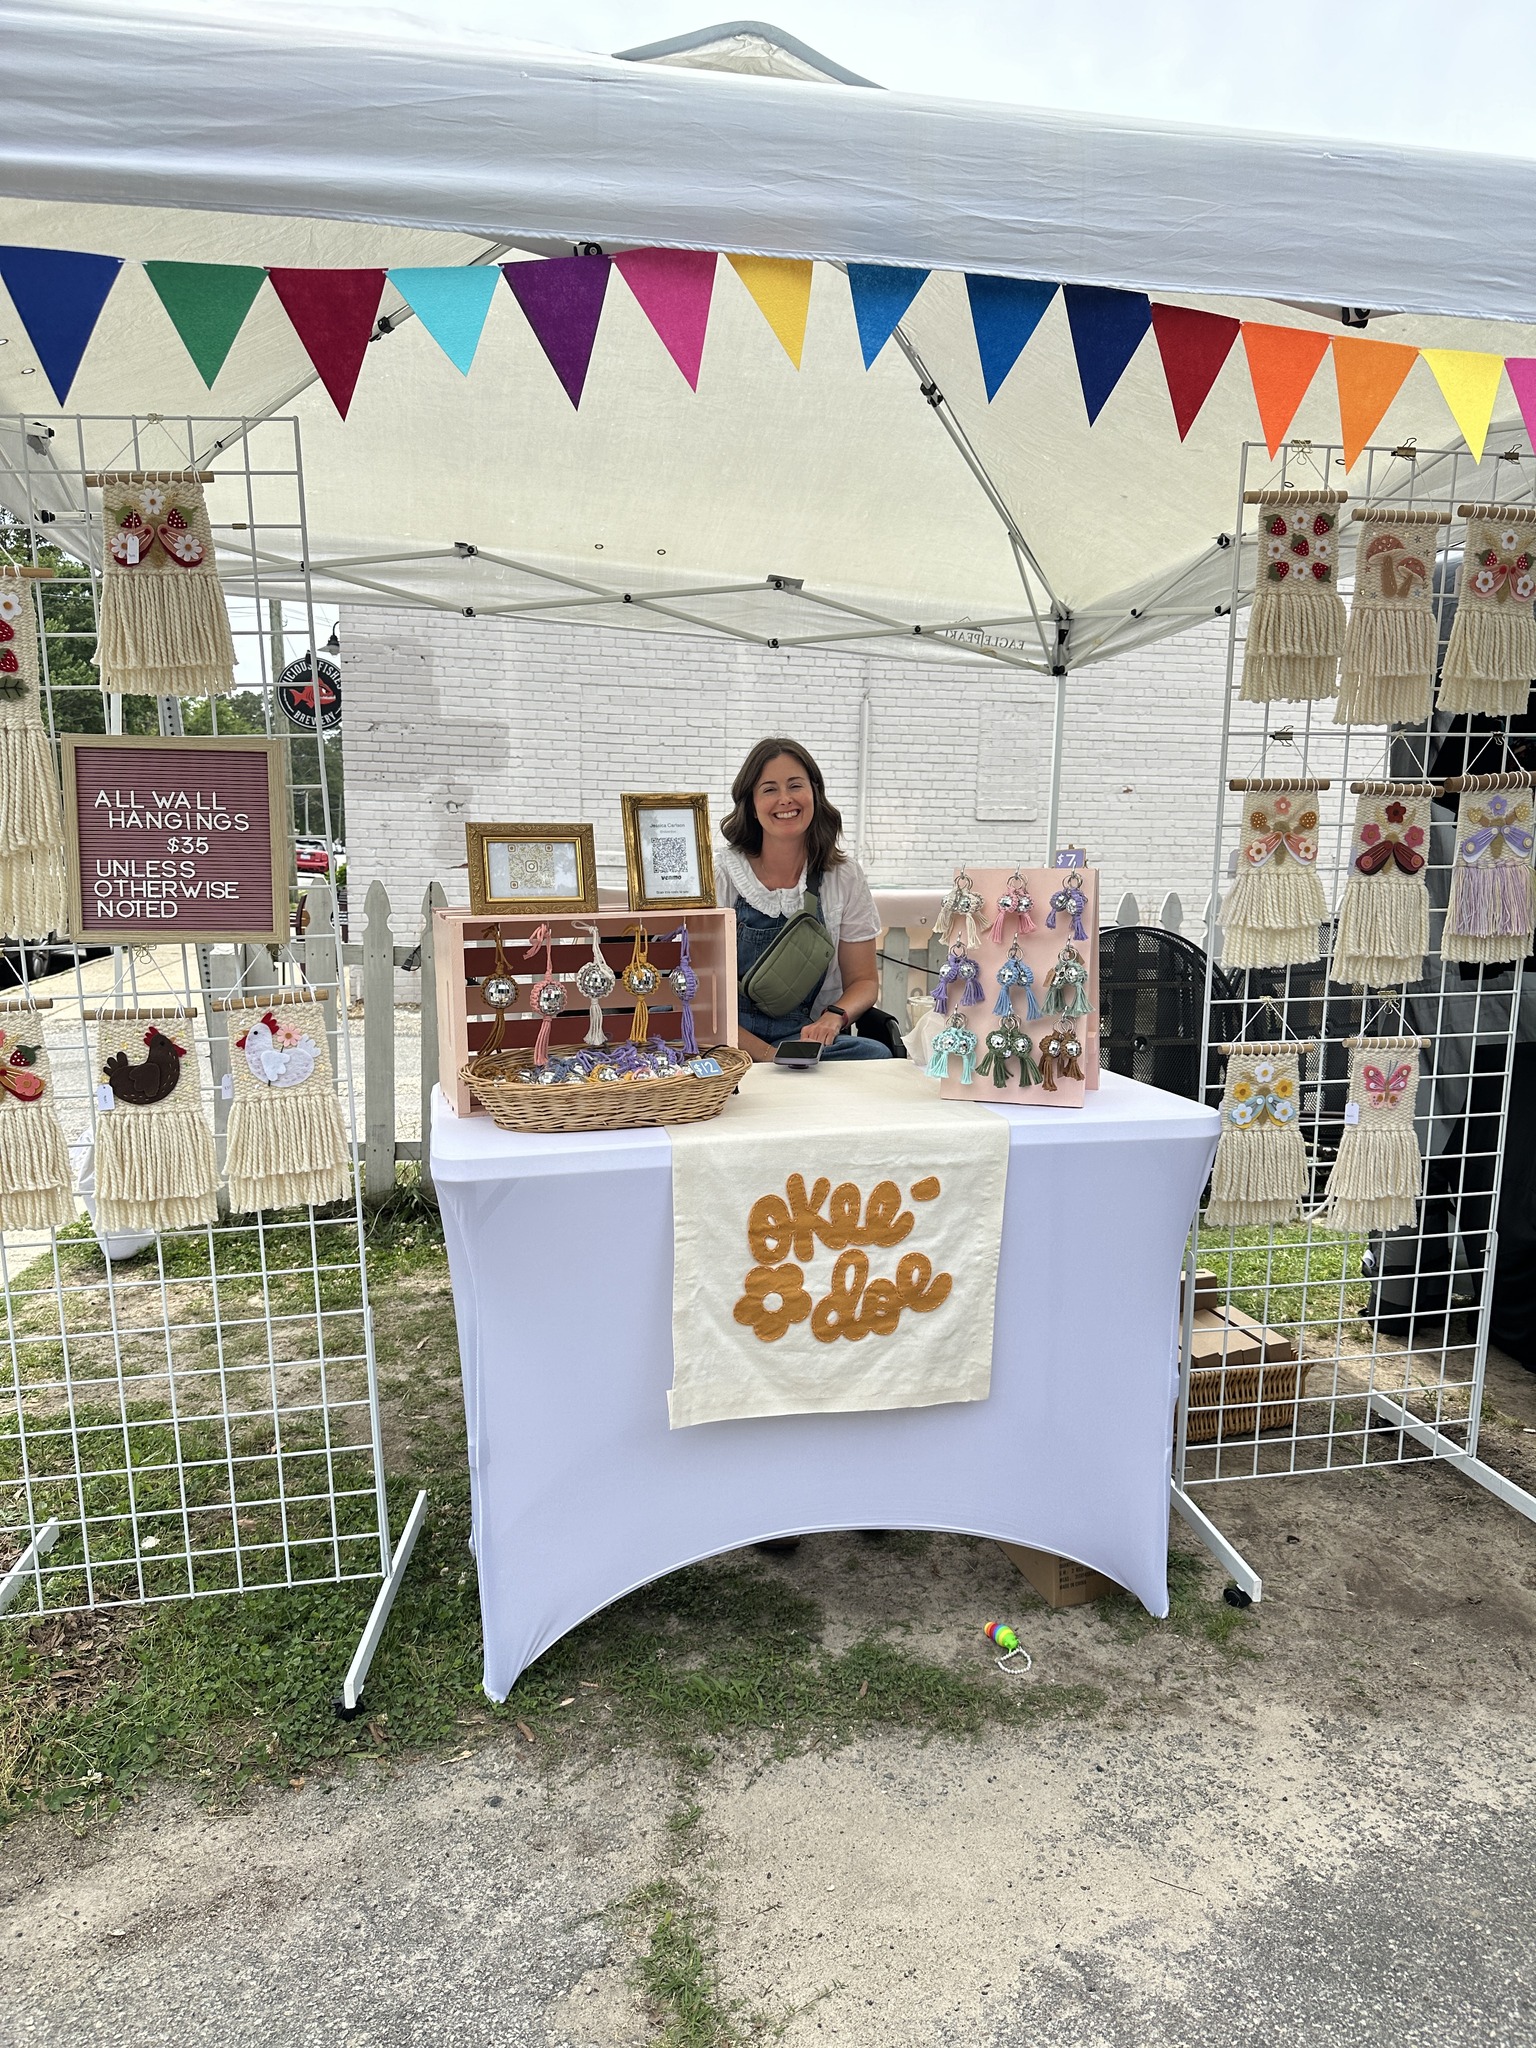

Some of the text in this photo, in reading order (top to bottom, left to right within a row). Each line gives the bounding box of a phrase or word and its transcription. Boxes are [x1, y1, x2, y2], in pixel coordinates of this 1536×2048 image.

[94, 789, 226, 810] ALL WALL
[108, 810, 249, 831] HANGINGS
[166, 836, 210, 854] $35
[96, 859, 196, 879] UNLESS
[1056, 853, 1077, 867] $7
[94, 879, 240, 899] OTHERWISE
[97, 899, 178, 918] NOTED
[693, 1061, 719, 1075] $12
